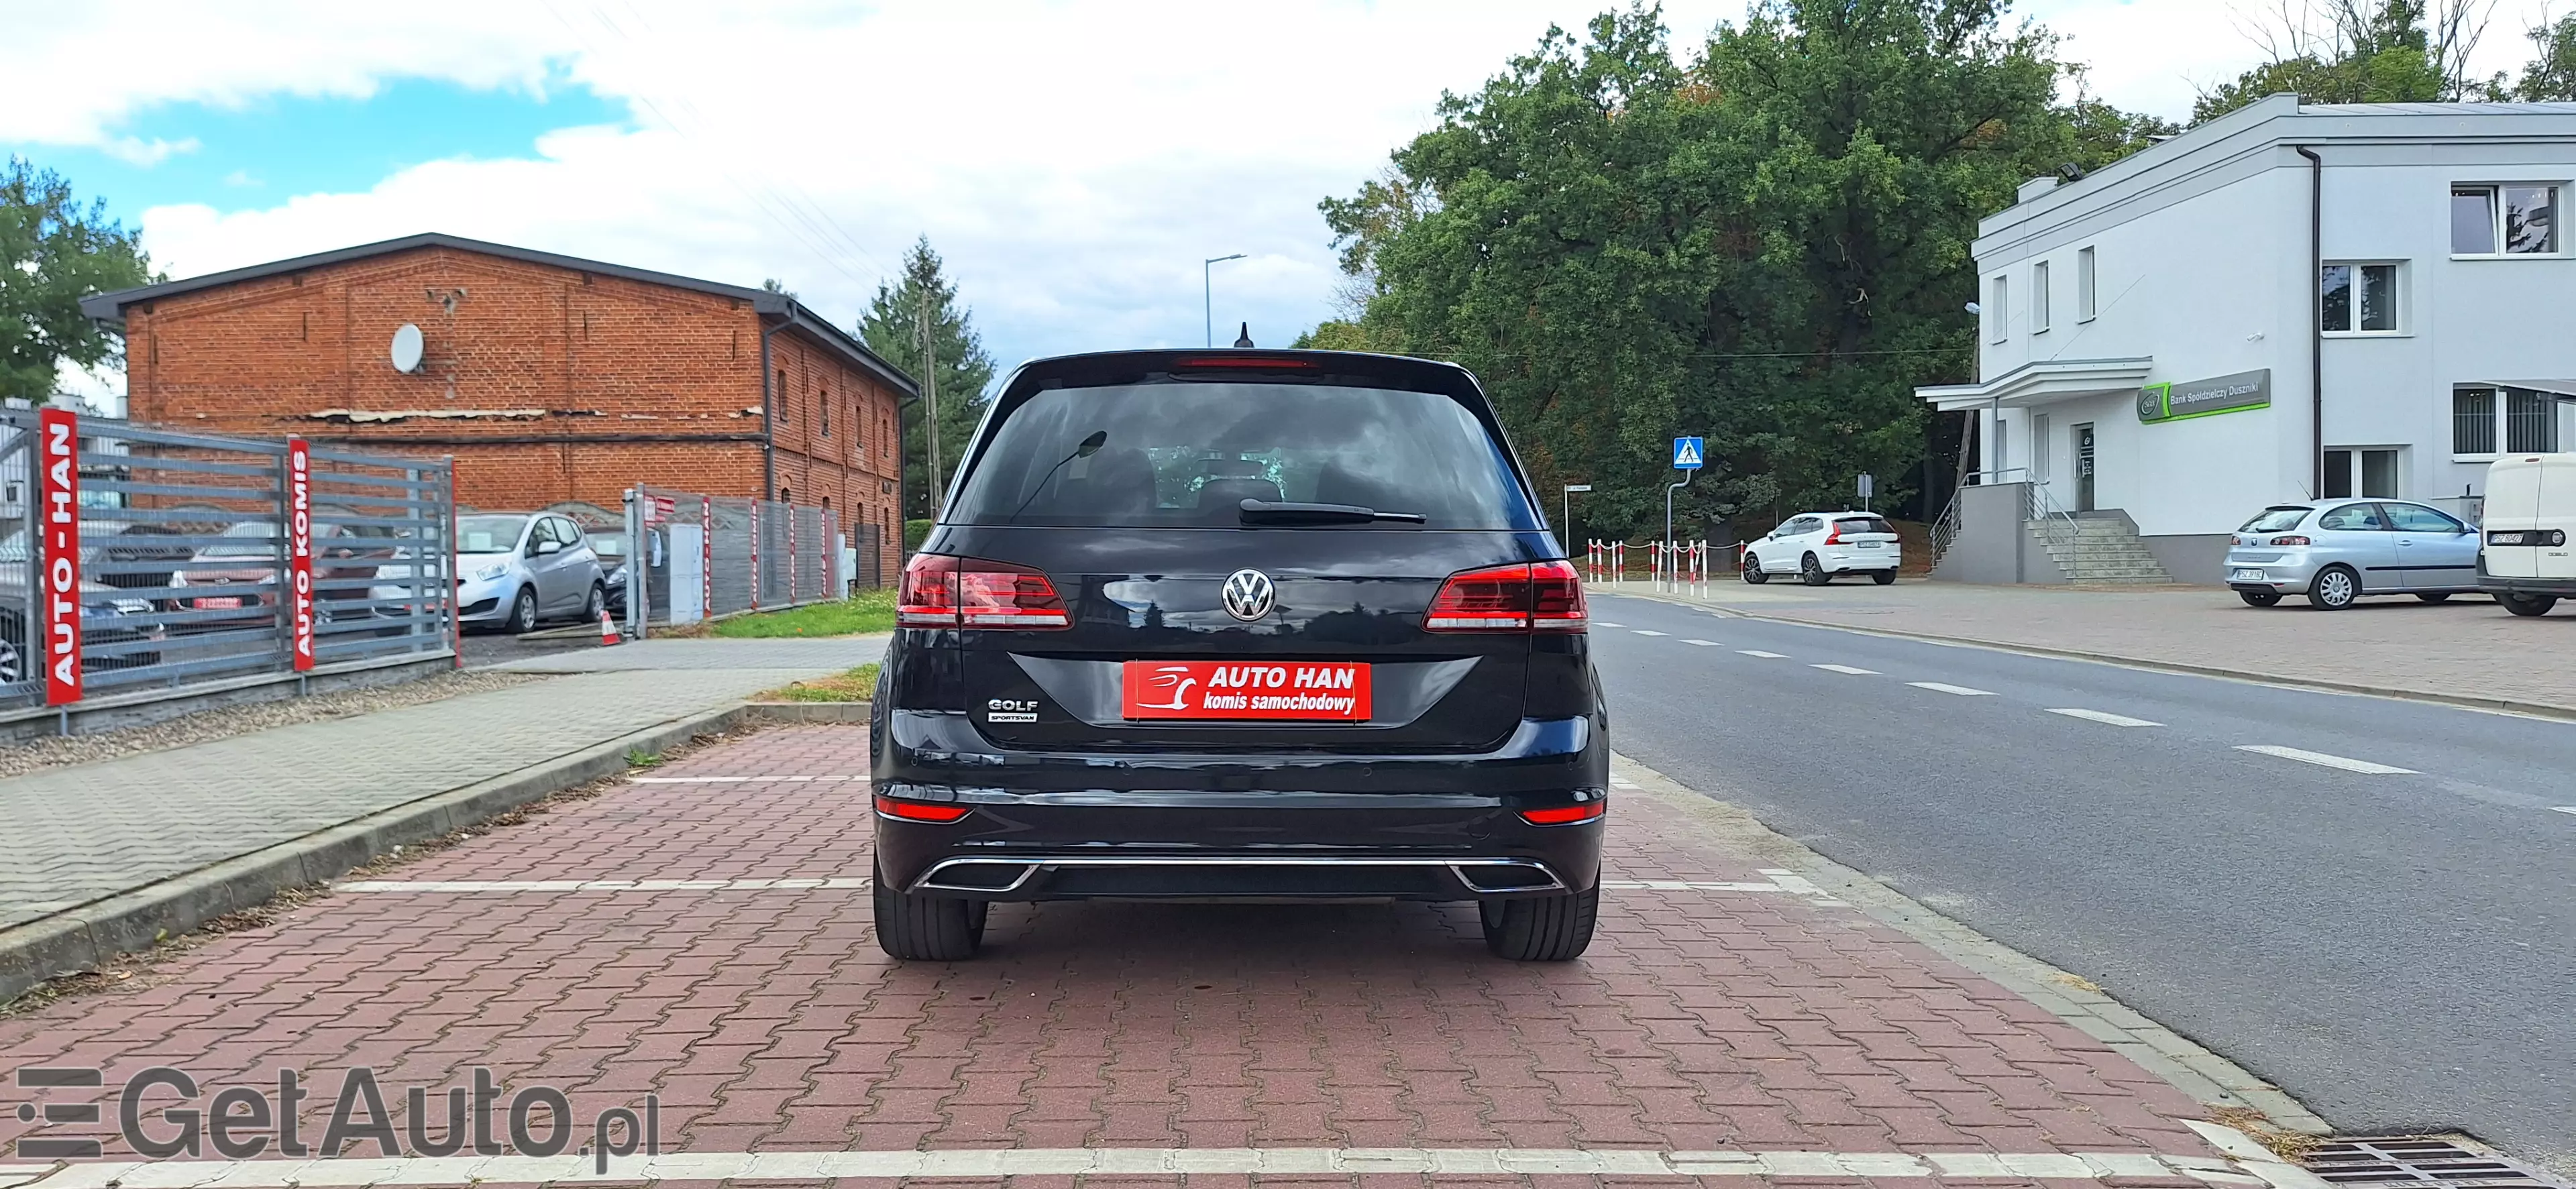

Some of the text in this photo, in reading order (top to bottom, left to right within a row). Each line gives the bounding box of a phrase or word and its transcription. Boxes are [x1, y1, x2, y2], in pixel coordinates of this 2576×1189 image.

[2170, 381, 2259, 405] Bank Spółdzielczy Duszniki
[293, 450, 311, 657] AUTO KOMIS
[1208, 667, 1355, 689] AUTO HAN
[988, 699, 1038, 711] GOLF
[1203, 691, 1355, 715] komis samochodowy
